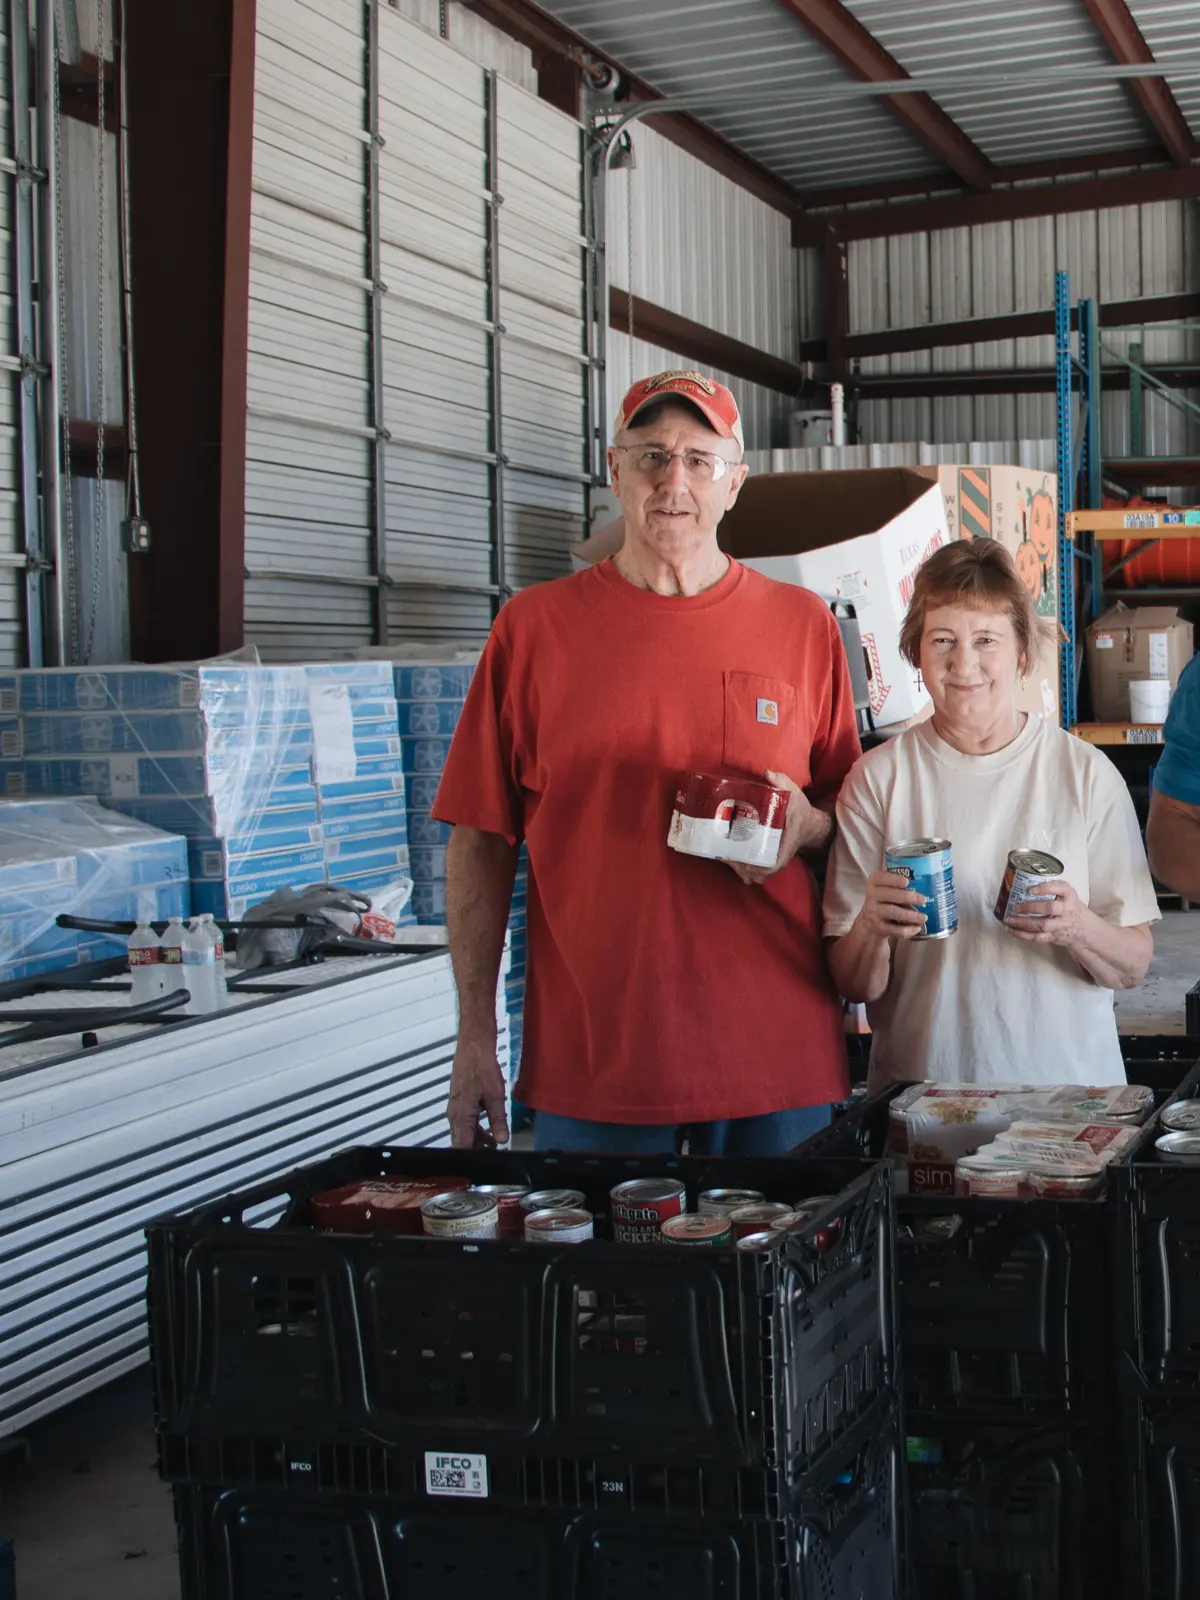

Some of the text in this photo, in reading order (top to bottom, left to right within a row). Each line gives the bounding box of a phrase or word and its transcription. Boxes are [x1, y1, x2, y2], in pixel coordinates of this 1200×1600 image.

[1167, 513, 1178, 524] 10
[230, 880, 258, 895] Lasko
[913, 1166, 952, 1186] sim
[290, 1461, 312, 1472] IFCO
[436, 1456, 472, 1470] IFCO
[602, 1481, 624, 1492] 23N
